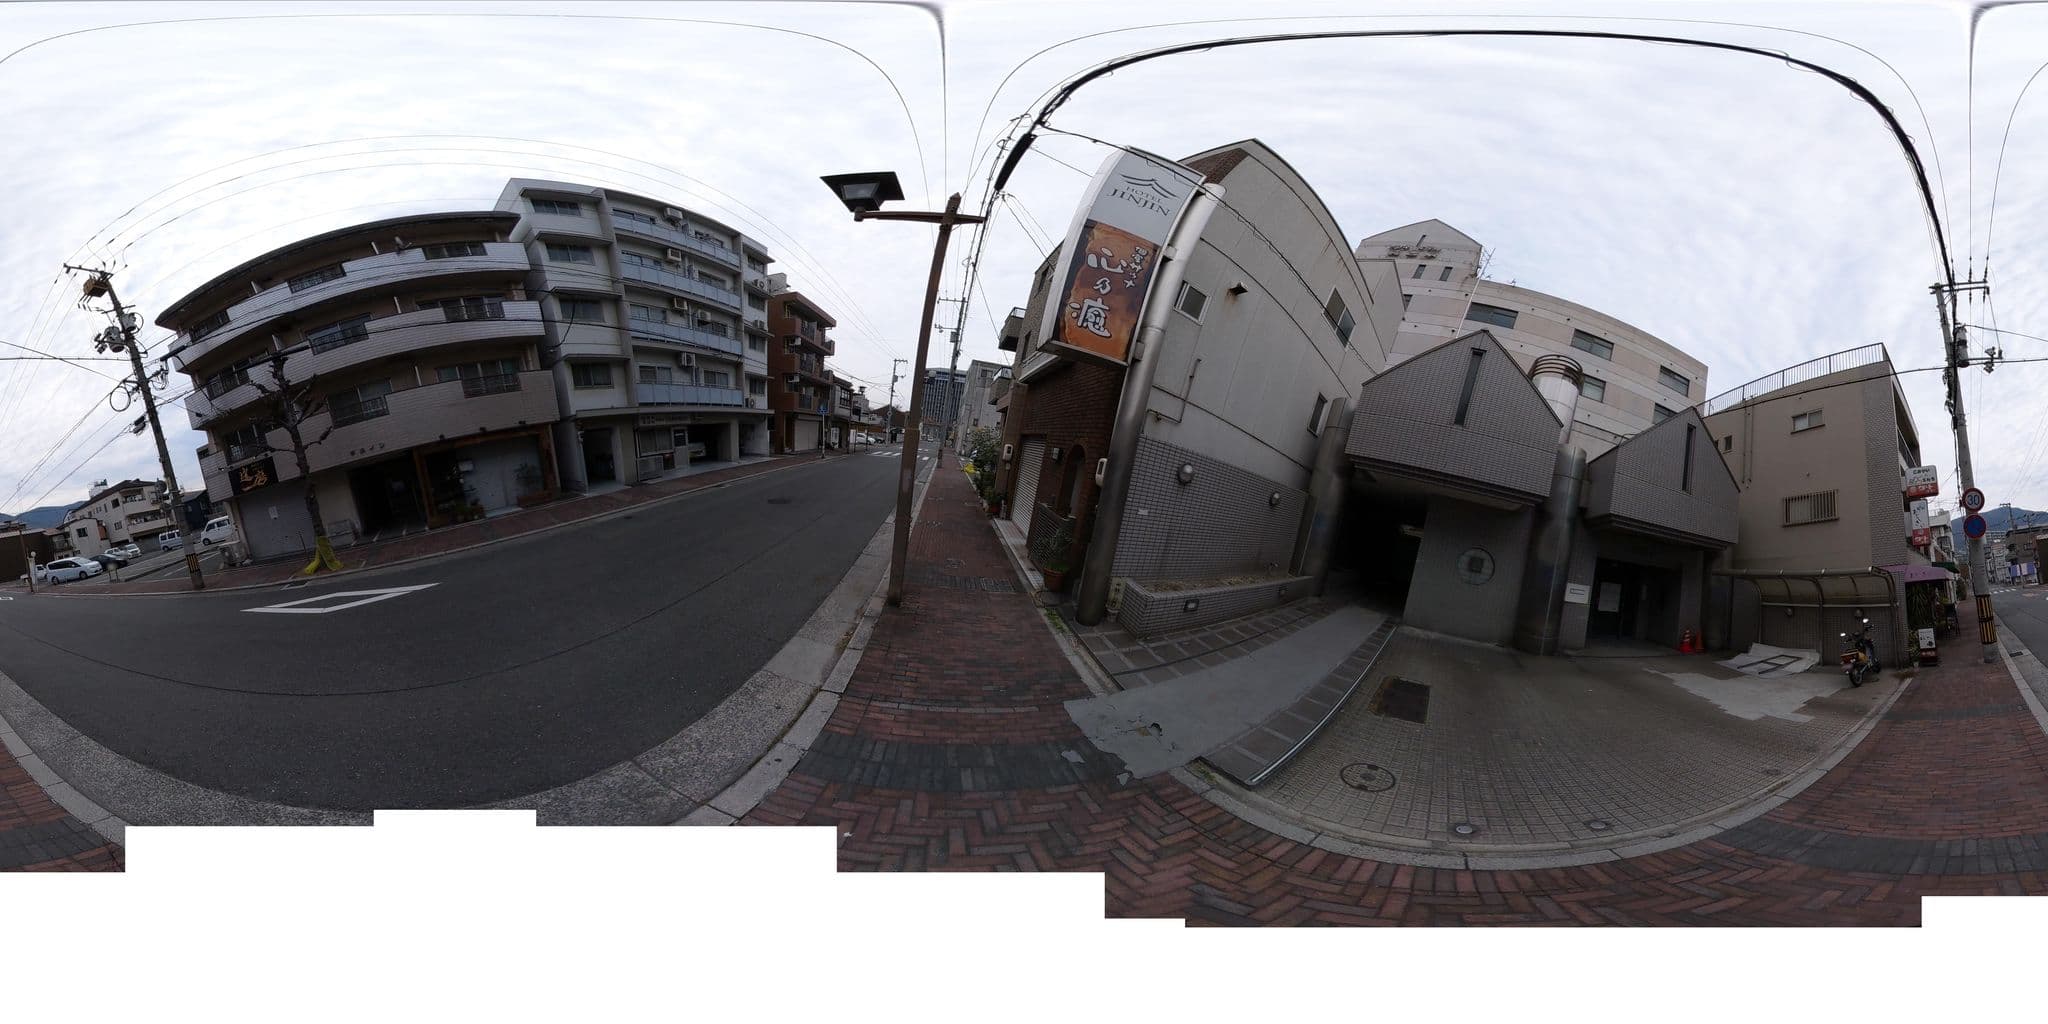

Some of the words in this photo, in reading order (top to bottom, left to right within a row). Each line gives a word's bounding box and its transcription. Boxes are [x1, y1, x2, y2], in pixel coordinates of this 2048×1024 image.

[1107, 188, 1170, 216] JINJIN
[1125, 186, 1163, 202] HOTEL
[1967, 494, 1980, 506] 30
